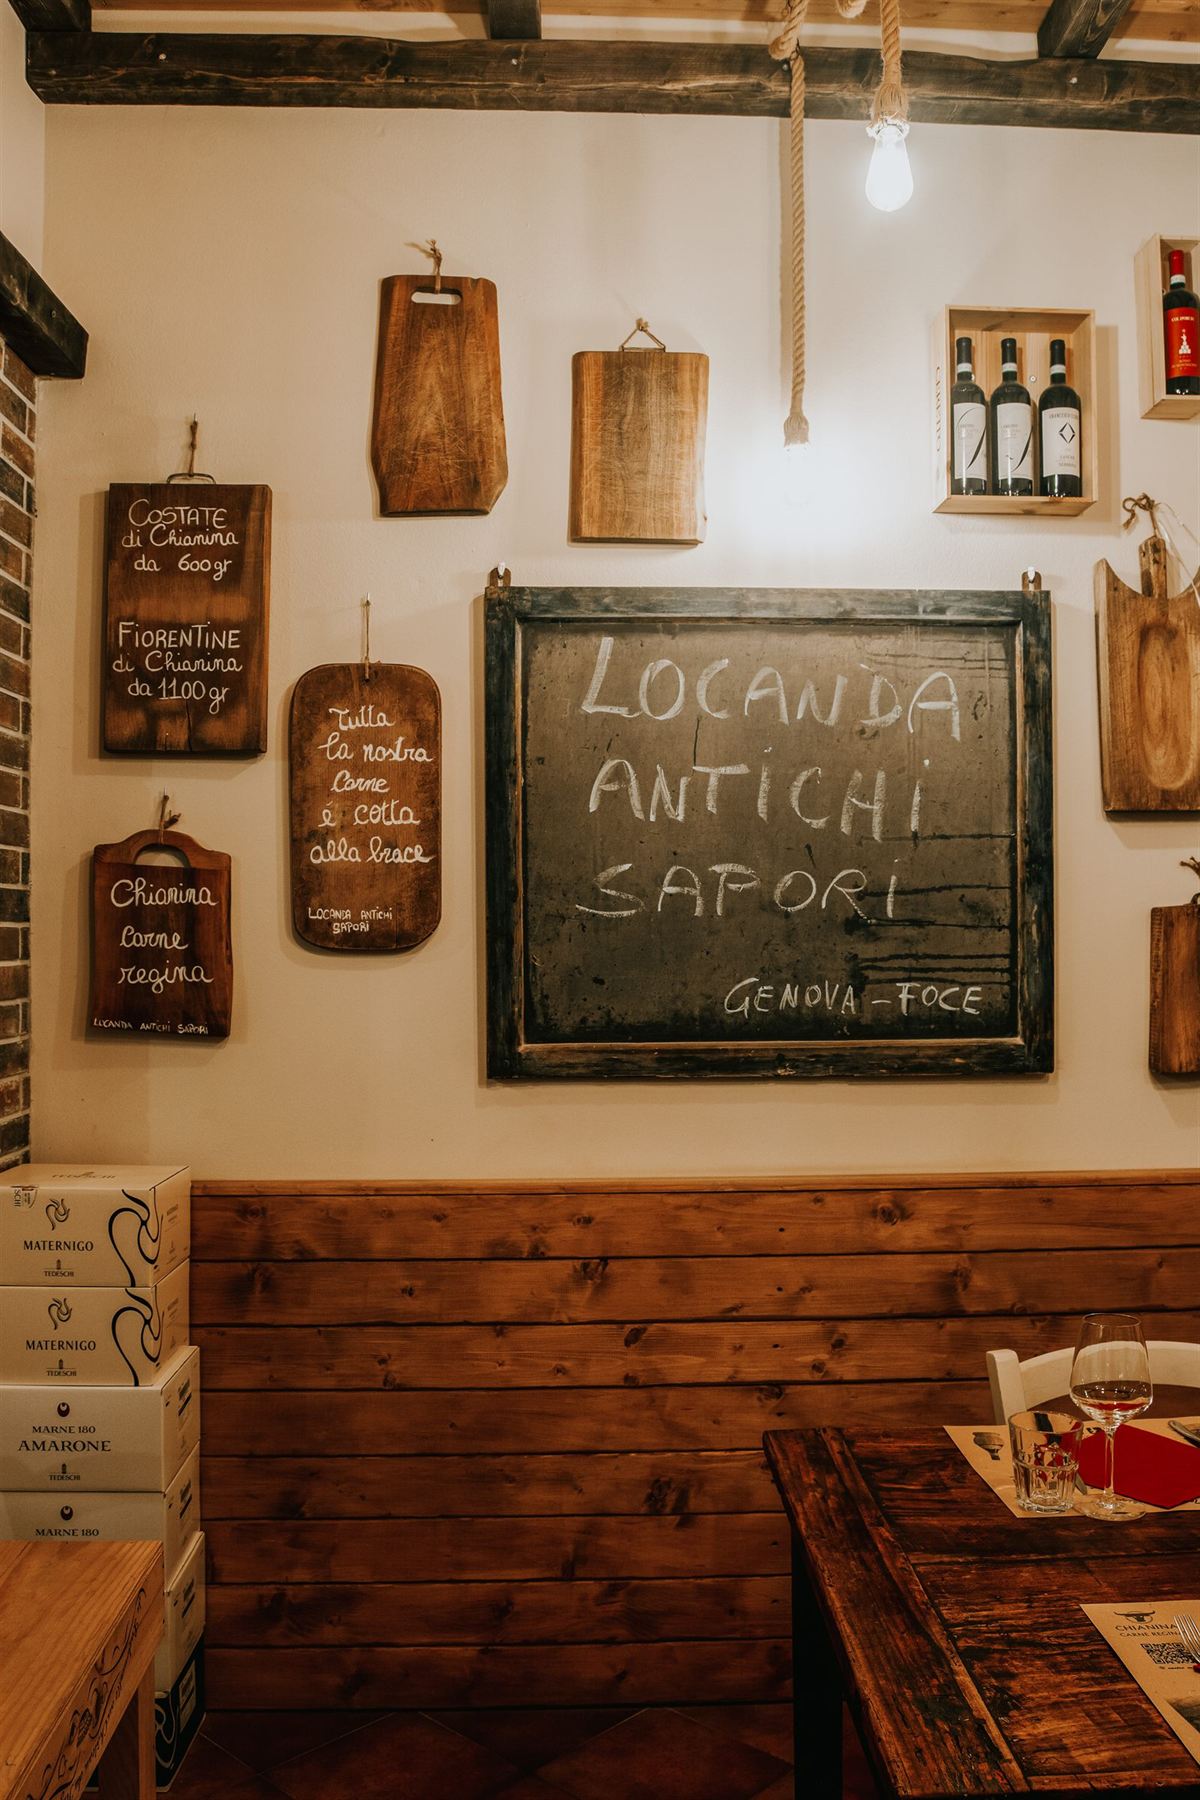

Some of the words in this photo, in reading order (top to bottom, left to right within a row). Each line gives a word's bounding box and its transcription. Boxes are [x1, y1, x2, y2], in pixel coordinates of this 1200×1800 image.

[121, 529, 142, 548] di
[149, 523, 240, 547] Chianina
[134, 554, 161, 572] da
[112, 652, 135, 673] di
[144, 650, 243, 673] Chianina
[127, 678, 153, 697] da
[580, 635, 961, 742] LOCANDA
[328, 704, 396, 732] Tutta
[317, 732, 355, 762] la
[362, 736, 434, 763] nostra
[352, 800, 421, 826] cotta
[309, 838, 362, 865] alla
[366, 836, 436, 865] brace
[110, 877, 219, 908] Chianina
[308, 907, 352, 920] LOCANDA
[117, 960, 215, 994] regina
[723, 976, 858, 1017] GENOVA
[895, 980, 983, 1017] FOCE
[23, 1240, 94, 1251] MATERNIGO
[25, 1340, 96, 1351] MATERNIGO
[32, 1426, 75, 1434] MARNE
[78, 1426, 96, 1434] 180
[18, 1440, 112, 1452] AMARONE
[35, 1529, 79, 1537] MARNE
[81, 1529, 99, 1537] 180
